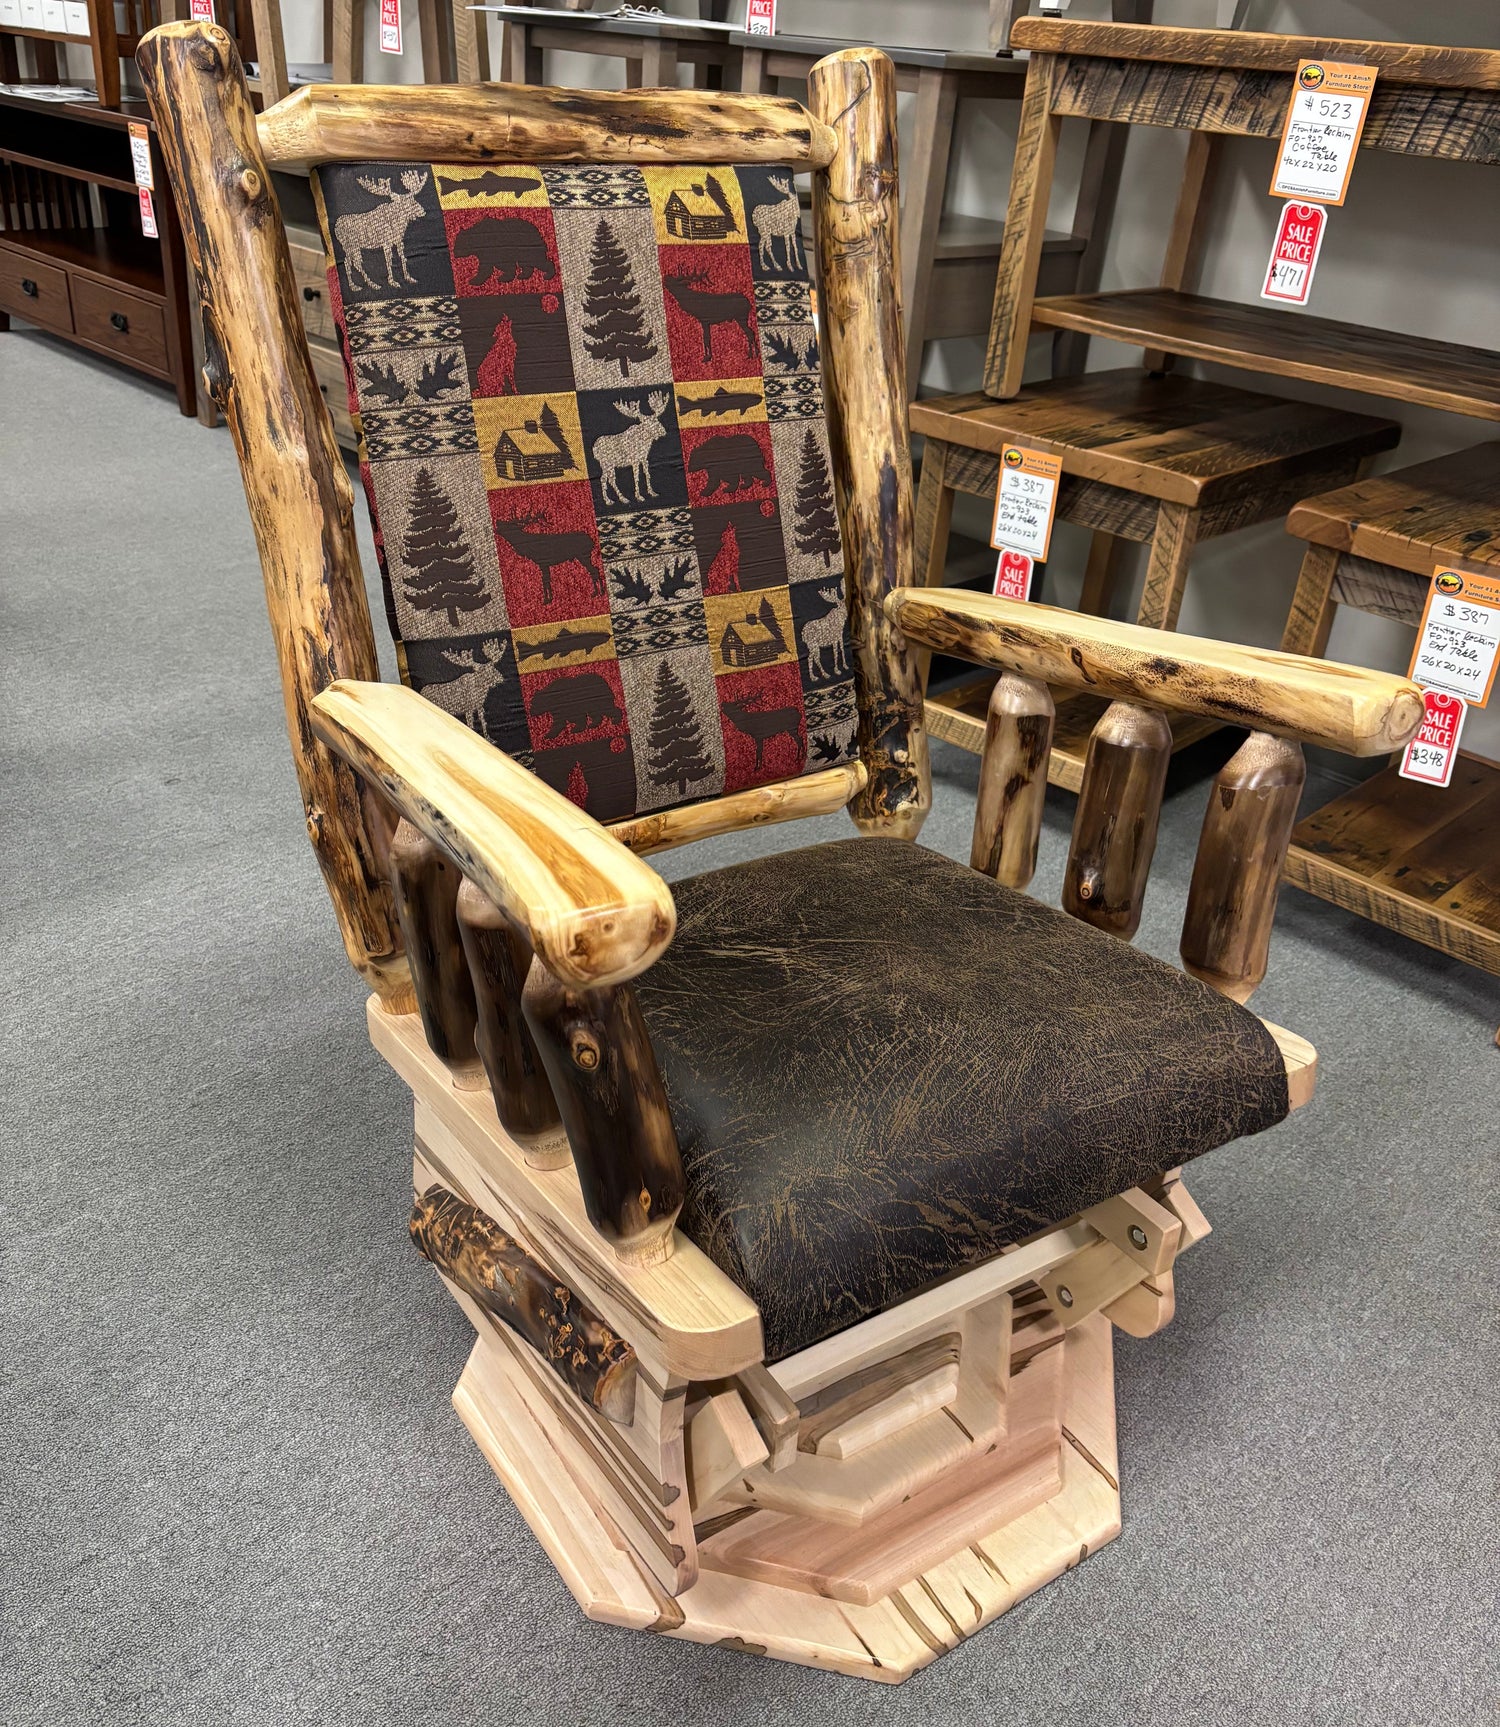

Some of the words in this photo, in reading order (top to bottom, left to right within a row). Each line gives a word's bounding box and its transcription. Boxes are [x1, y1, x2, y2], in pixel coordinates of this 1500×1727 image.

[752, 0, 772, 15] PRICE
[1325, 80, 1351, 89] Furniture
[1319, 99, 1352, 119] 523
[1286, 223, 1313, 244] SALE
[1280, 240, 1312, 262] PRICE
[1004, 567, 1024, 584] SALE
[1000, 580, 1024, 599] PRICE
[1464, 589, 1493, 601] Furniture
[1469, 582, 1484, 590] Your
[1459, 607, 1489, 625] 387
[1428, 641, 1446, 652] End
[1424, 709, 1453, 729] SALE
[1418, 724, 1452, 747] PRICE
[1410, 747, 1444, 767] $348
